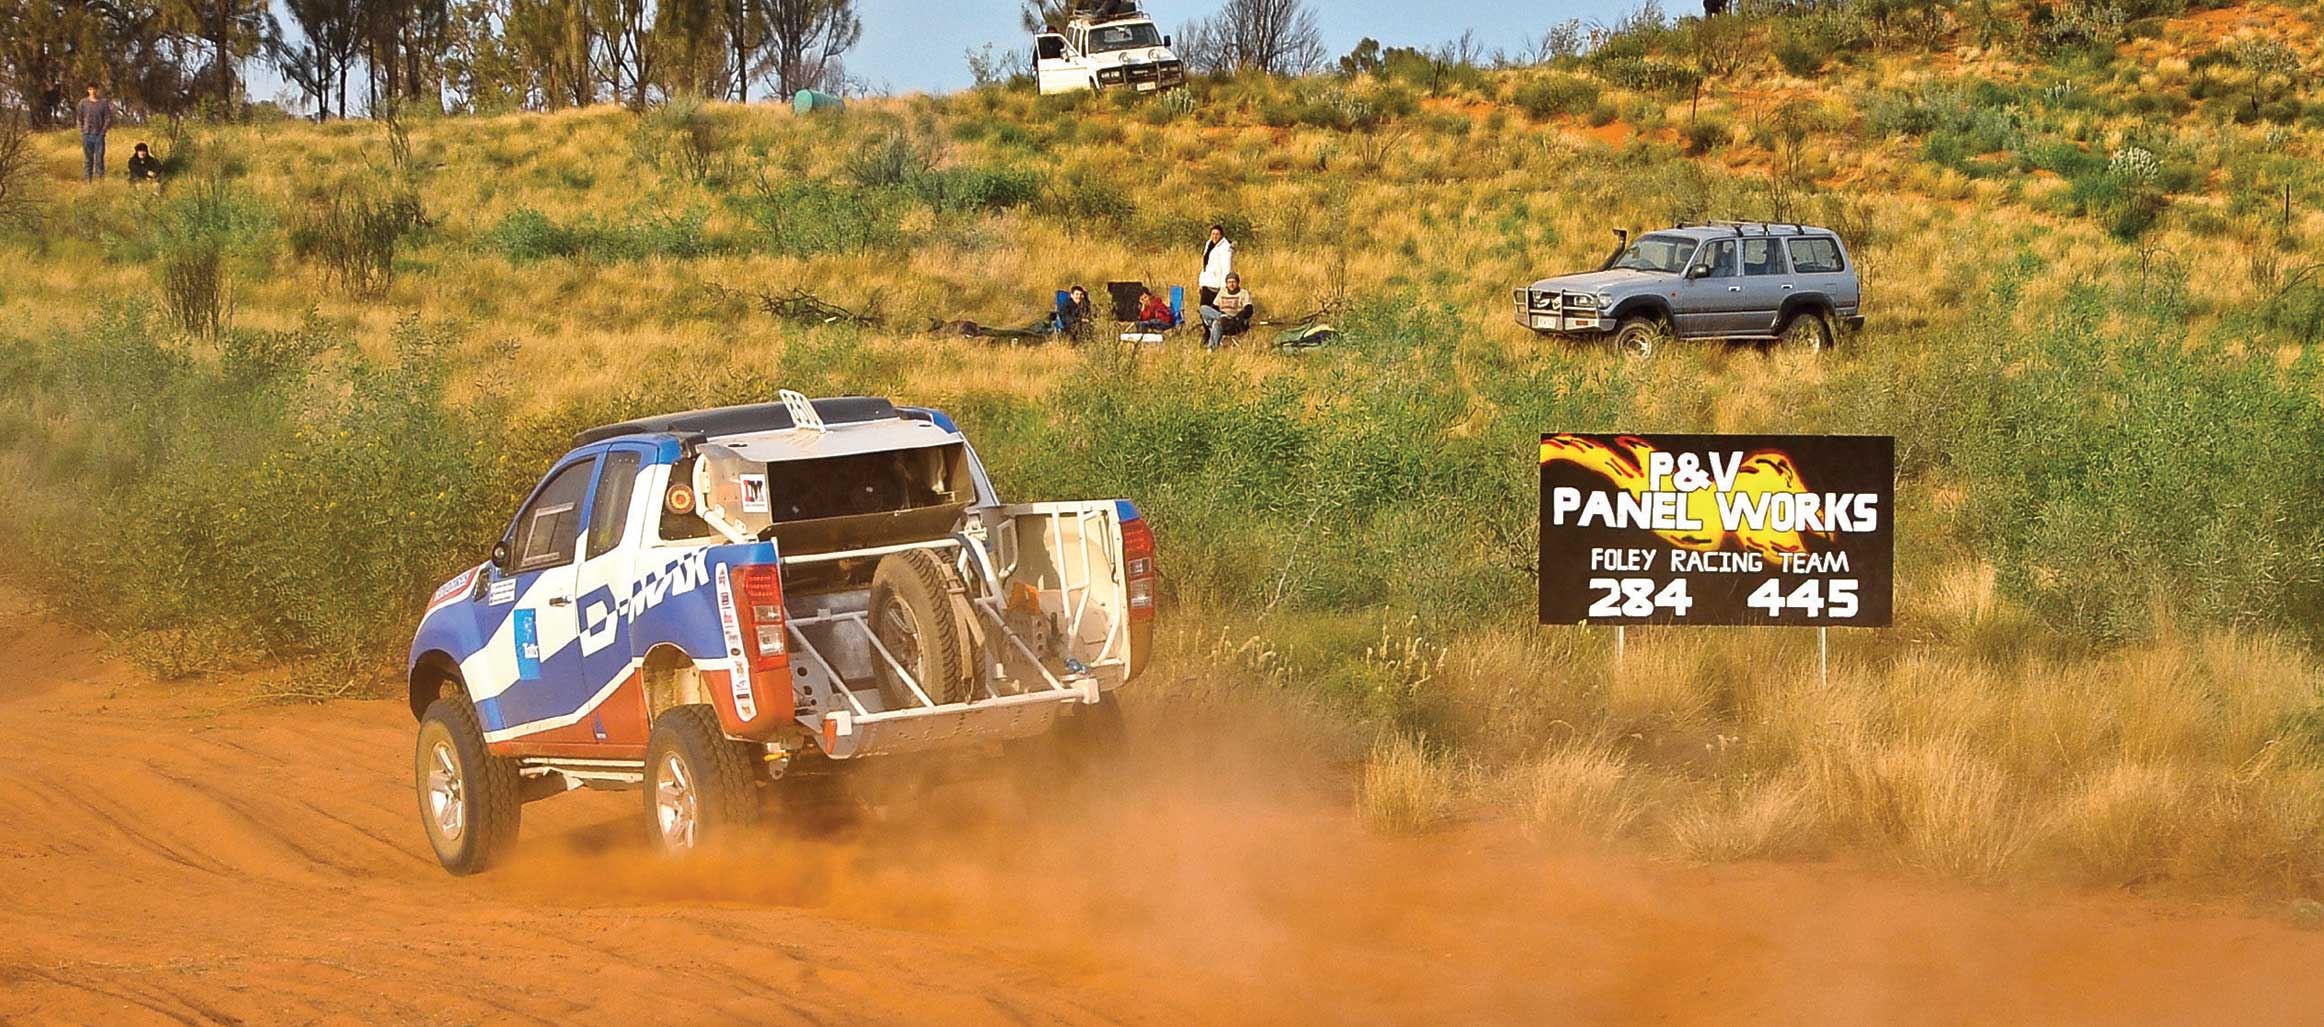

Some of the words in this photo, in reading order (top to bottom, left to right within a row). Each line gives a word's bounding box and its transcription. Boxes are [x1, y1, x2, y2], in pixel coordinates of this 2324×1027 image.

[1650, 451, 1744, 492] P&V
[1553, 486, 1702, 531] PANEL
[1715, 492, 1878, 532] WORKS
[1591, 548, 1657, 571] FOLEY
[1671, 550, 1763, 573] RACING
[1778, 551, 1850, 574] TEAM
[1588, 578, 1693, 617] 284
[1747, 578, 1859, 618] 445
